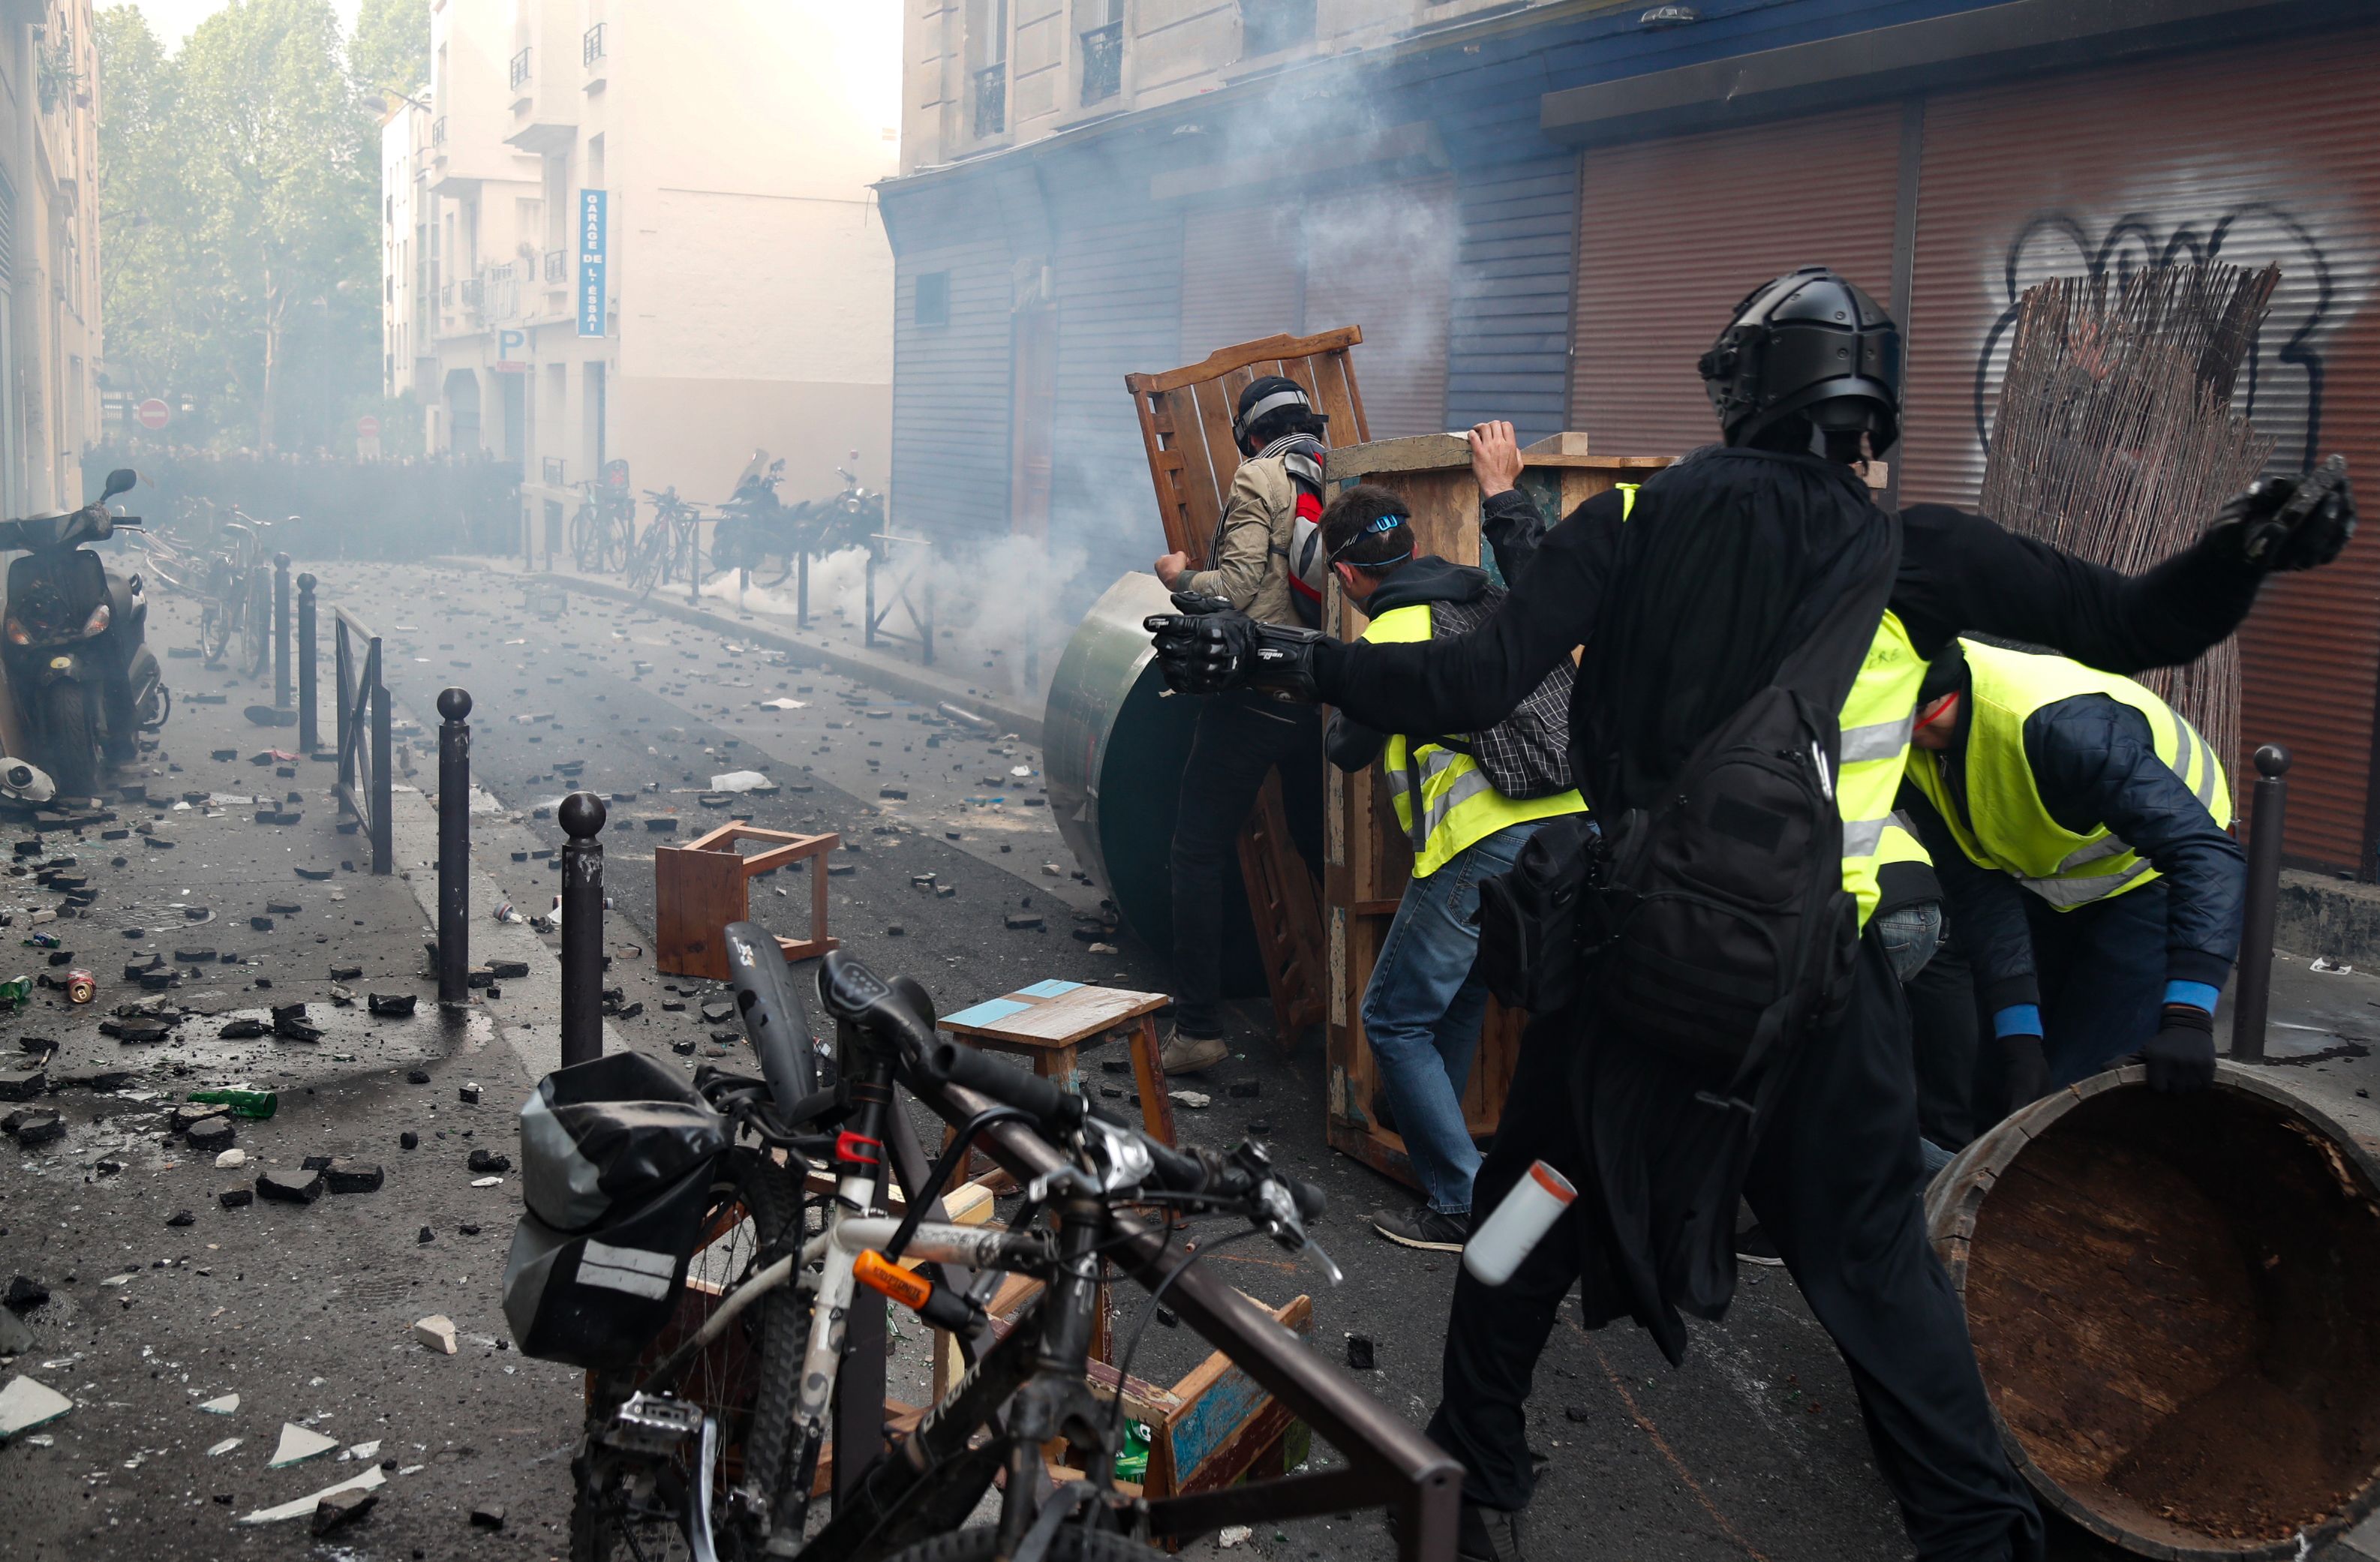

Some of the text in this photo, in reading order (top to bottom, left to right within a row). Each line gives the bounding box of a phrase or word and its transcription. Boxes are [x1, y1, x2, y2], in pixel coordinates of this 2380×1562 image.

[587, 194, 598, 250] GARAGE
[583, 255, 603, 263] DE
[500, 330, 524, 360] P
[873, 1266, 924, 1300] KRYPTONITE
